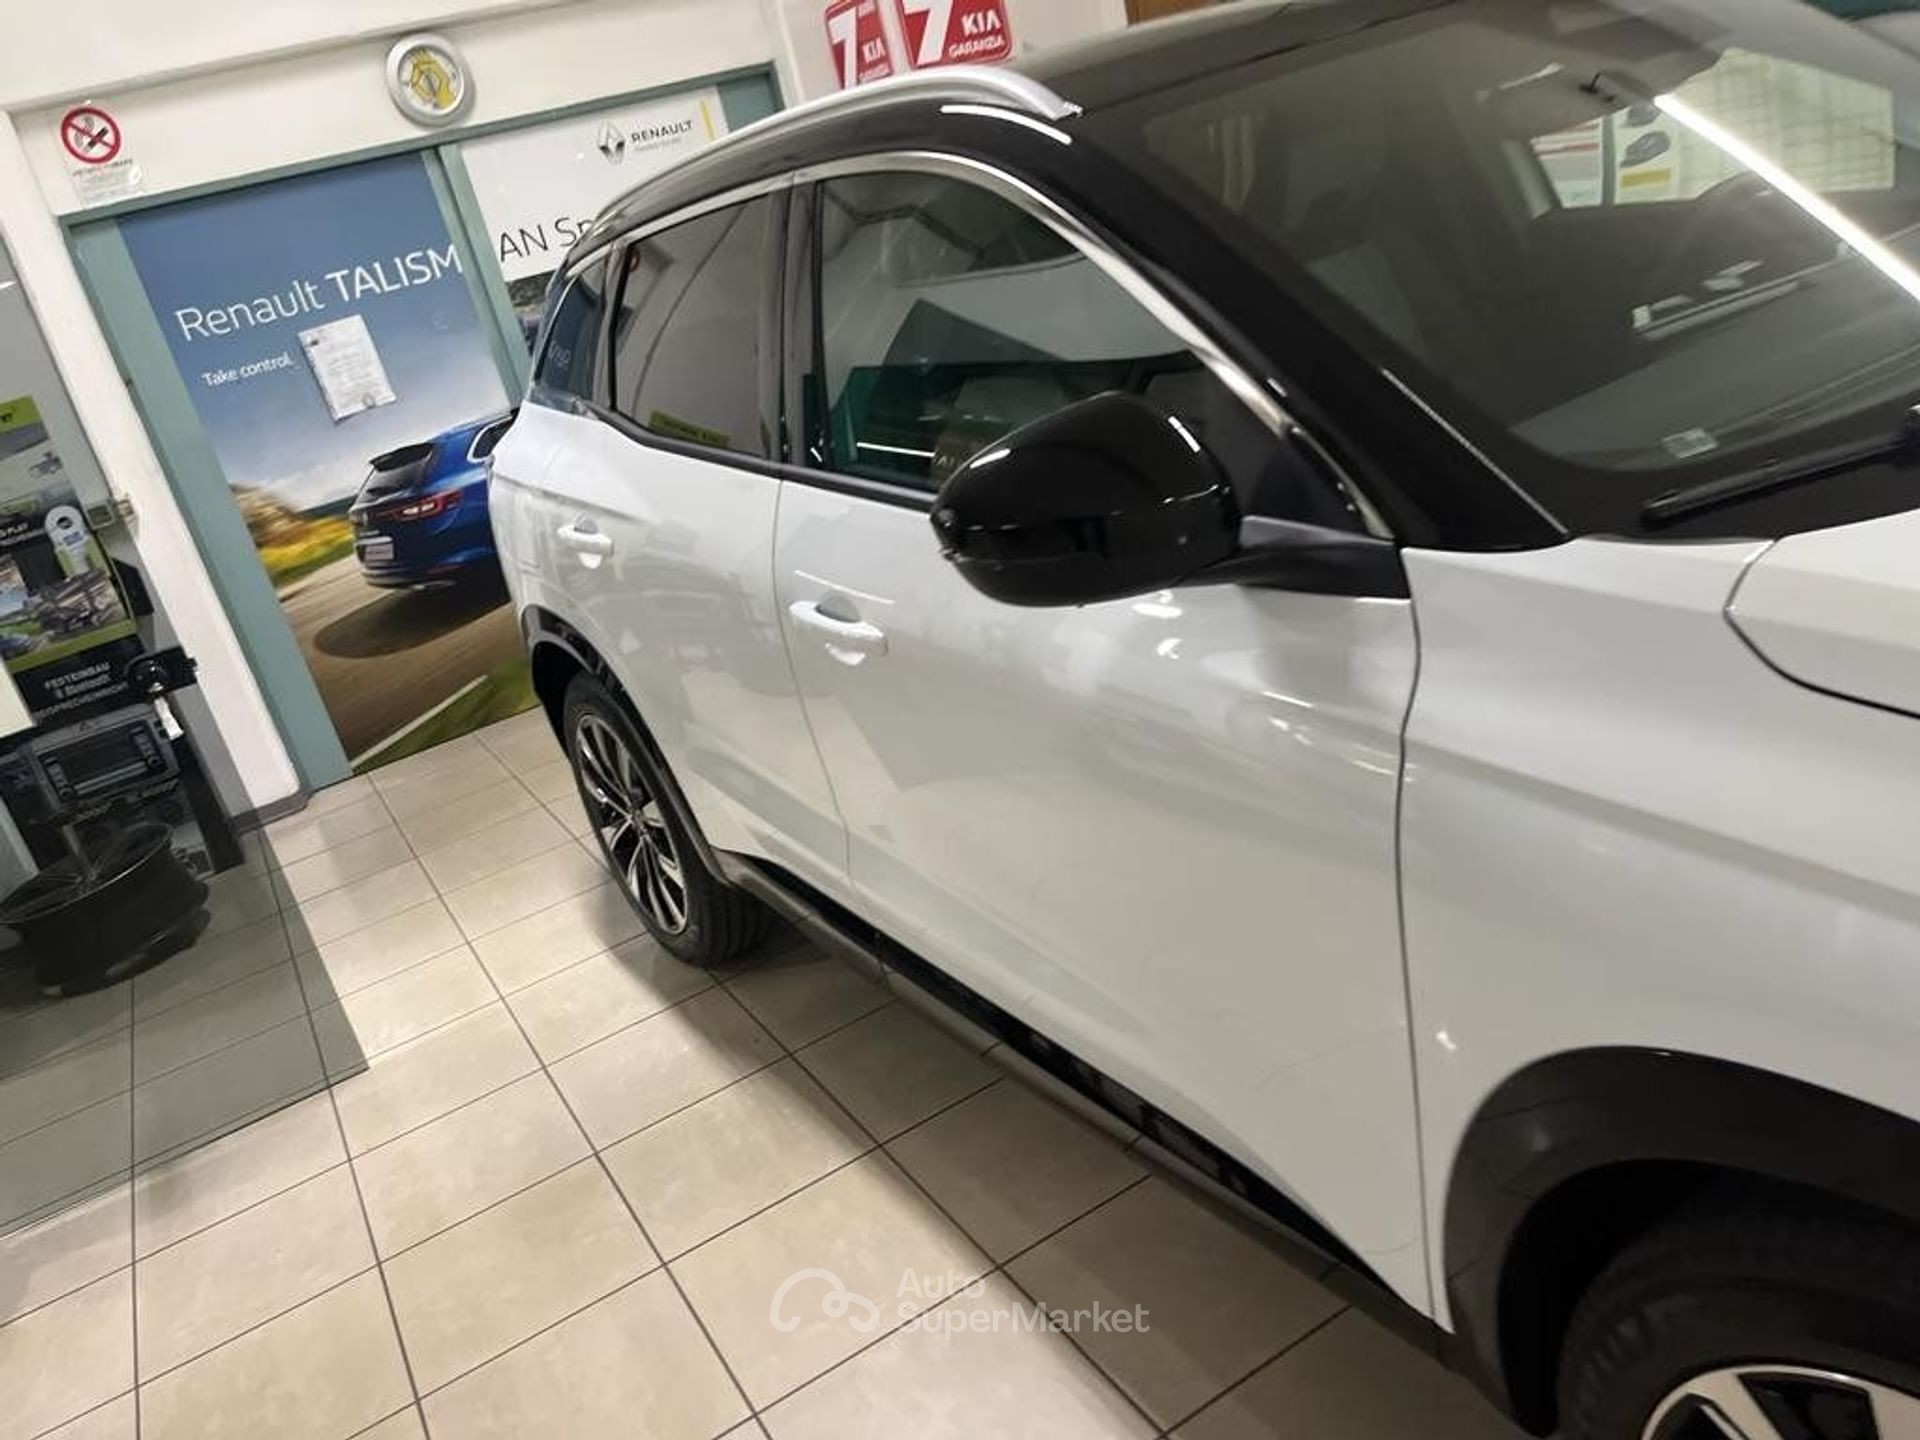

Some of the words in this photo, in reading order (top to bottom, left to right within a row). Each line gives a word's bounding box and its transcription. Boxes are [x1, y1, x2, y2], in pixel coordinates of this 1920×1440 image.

[904, 0, 953, 66] 7
[961, 9, 1001, 36] KIA
[862, 37, 887, 63] KIA
[630, 119, 693, 144] RENAULT
[500, 224, 549, 263] AN
[174, 279, 325, 341] Renault
[325, 244, 464, 302] TALISM
[201, 367, 239, 388] Take
